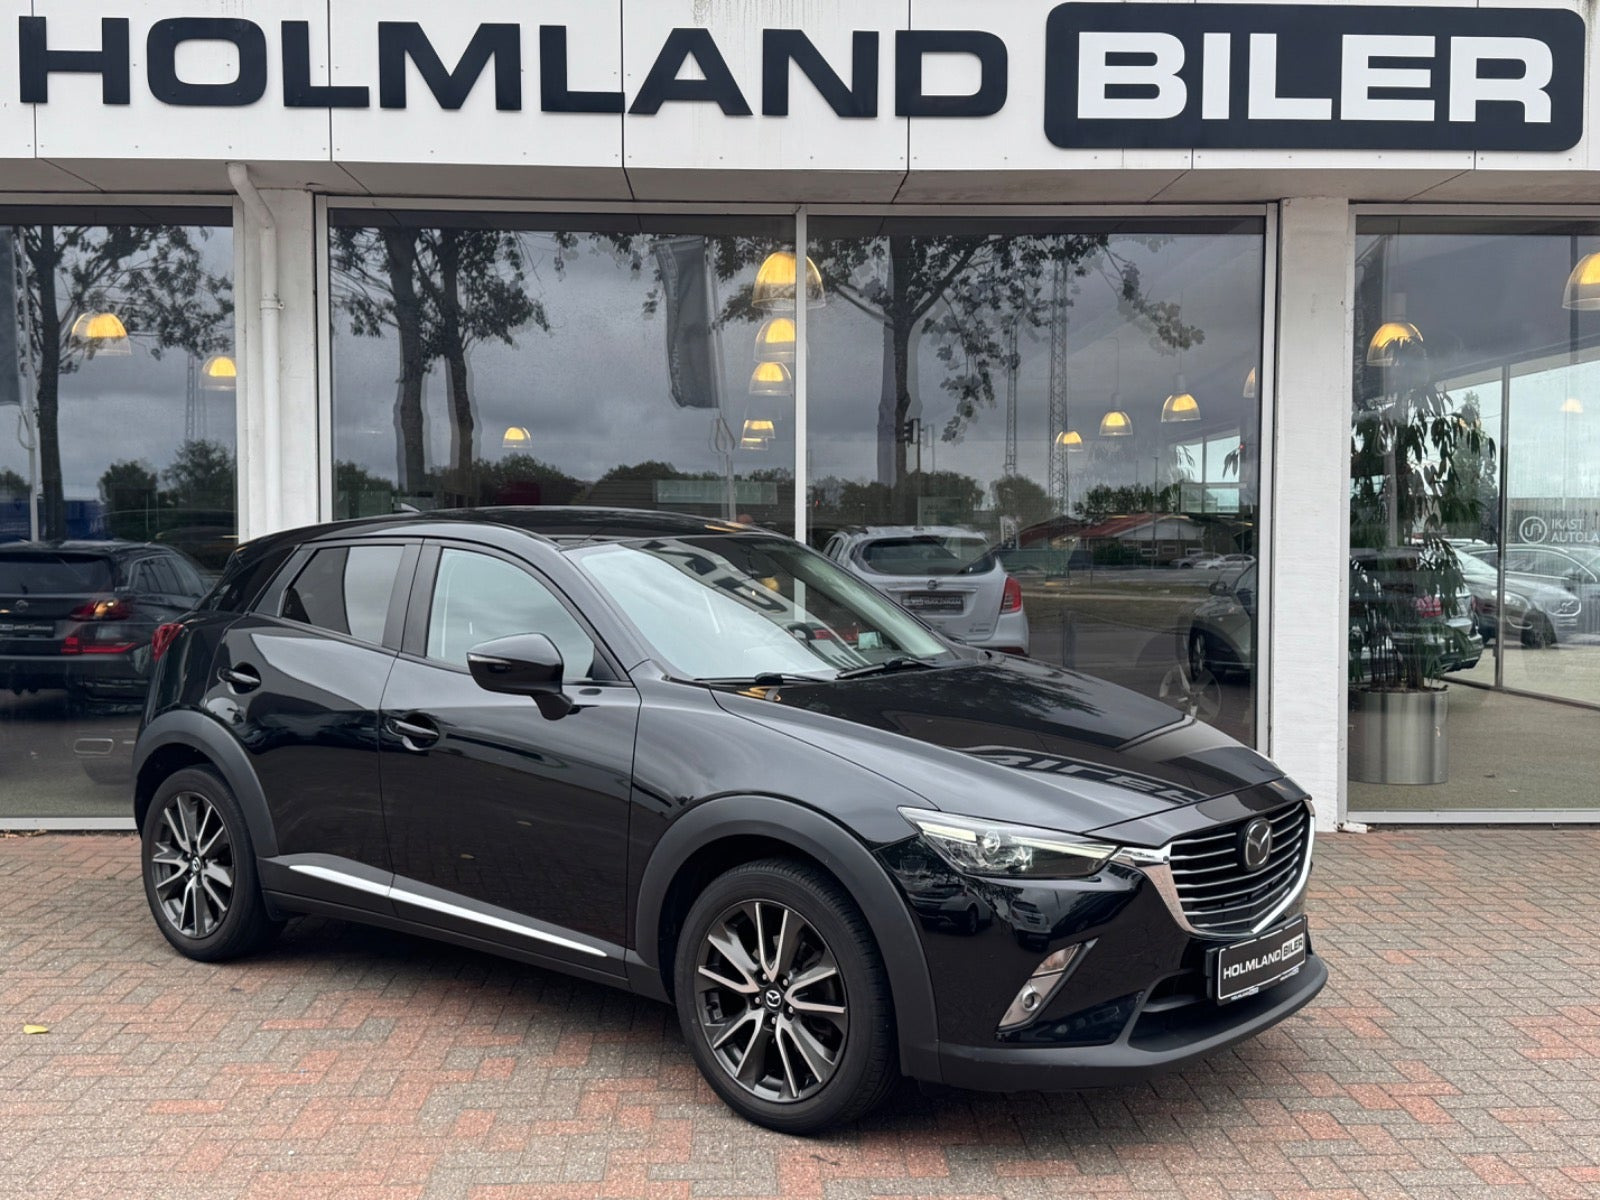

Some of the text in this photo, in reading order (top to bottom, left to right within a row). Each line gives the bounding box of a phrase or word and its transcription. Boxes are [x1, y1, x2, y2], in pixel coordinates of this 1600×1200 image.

[19, 16, 1553, 123] HOLMLAND BILER
[1551, 518, 1585, 530] IKAST
[1223, 949, 1282, 980] HOLMLAND
[1283, 935, 1304, 959] BILER
